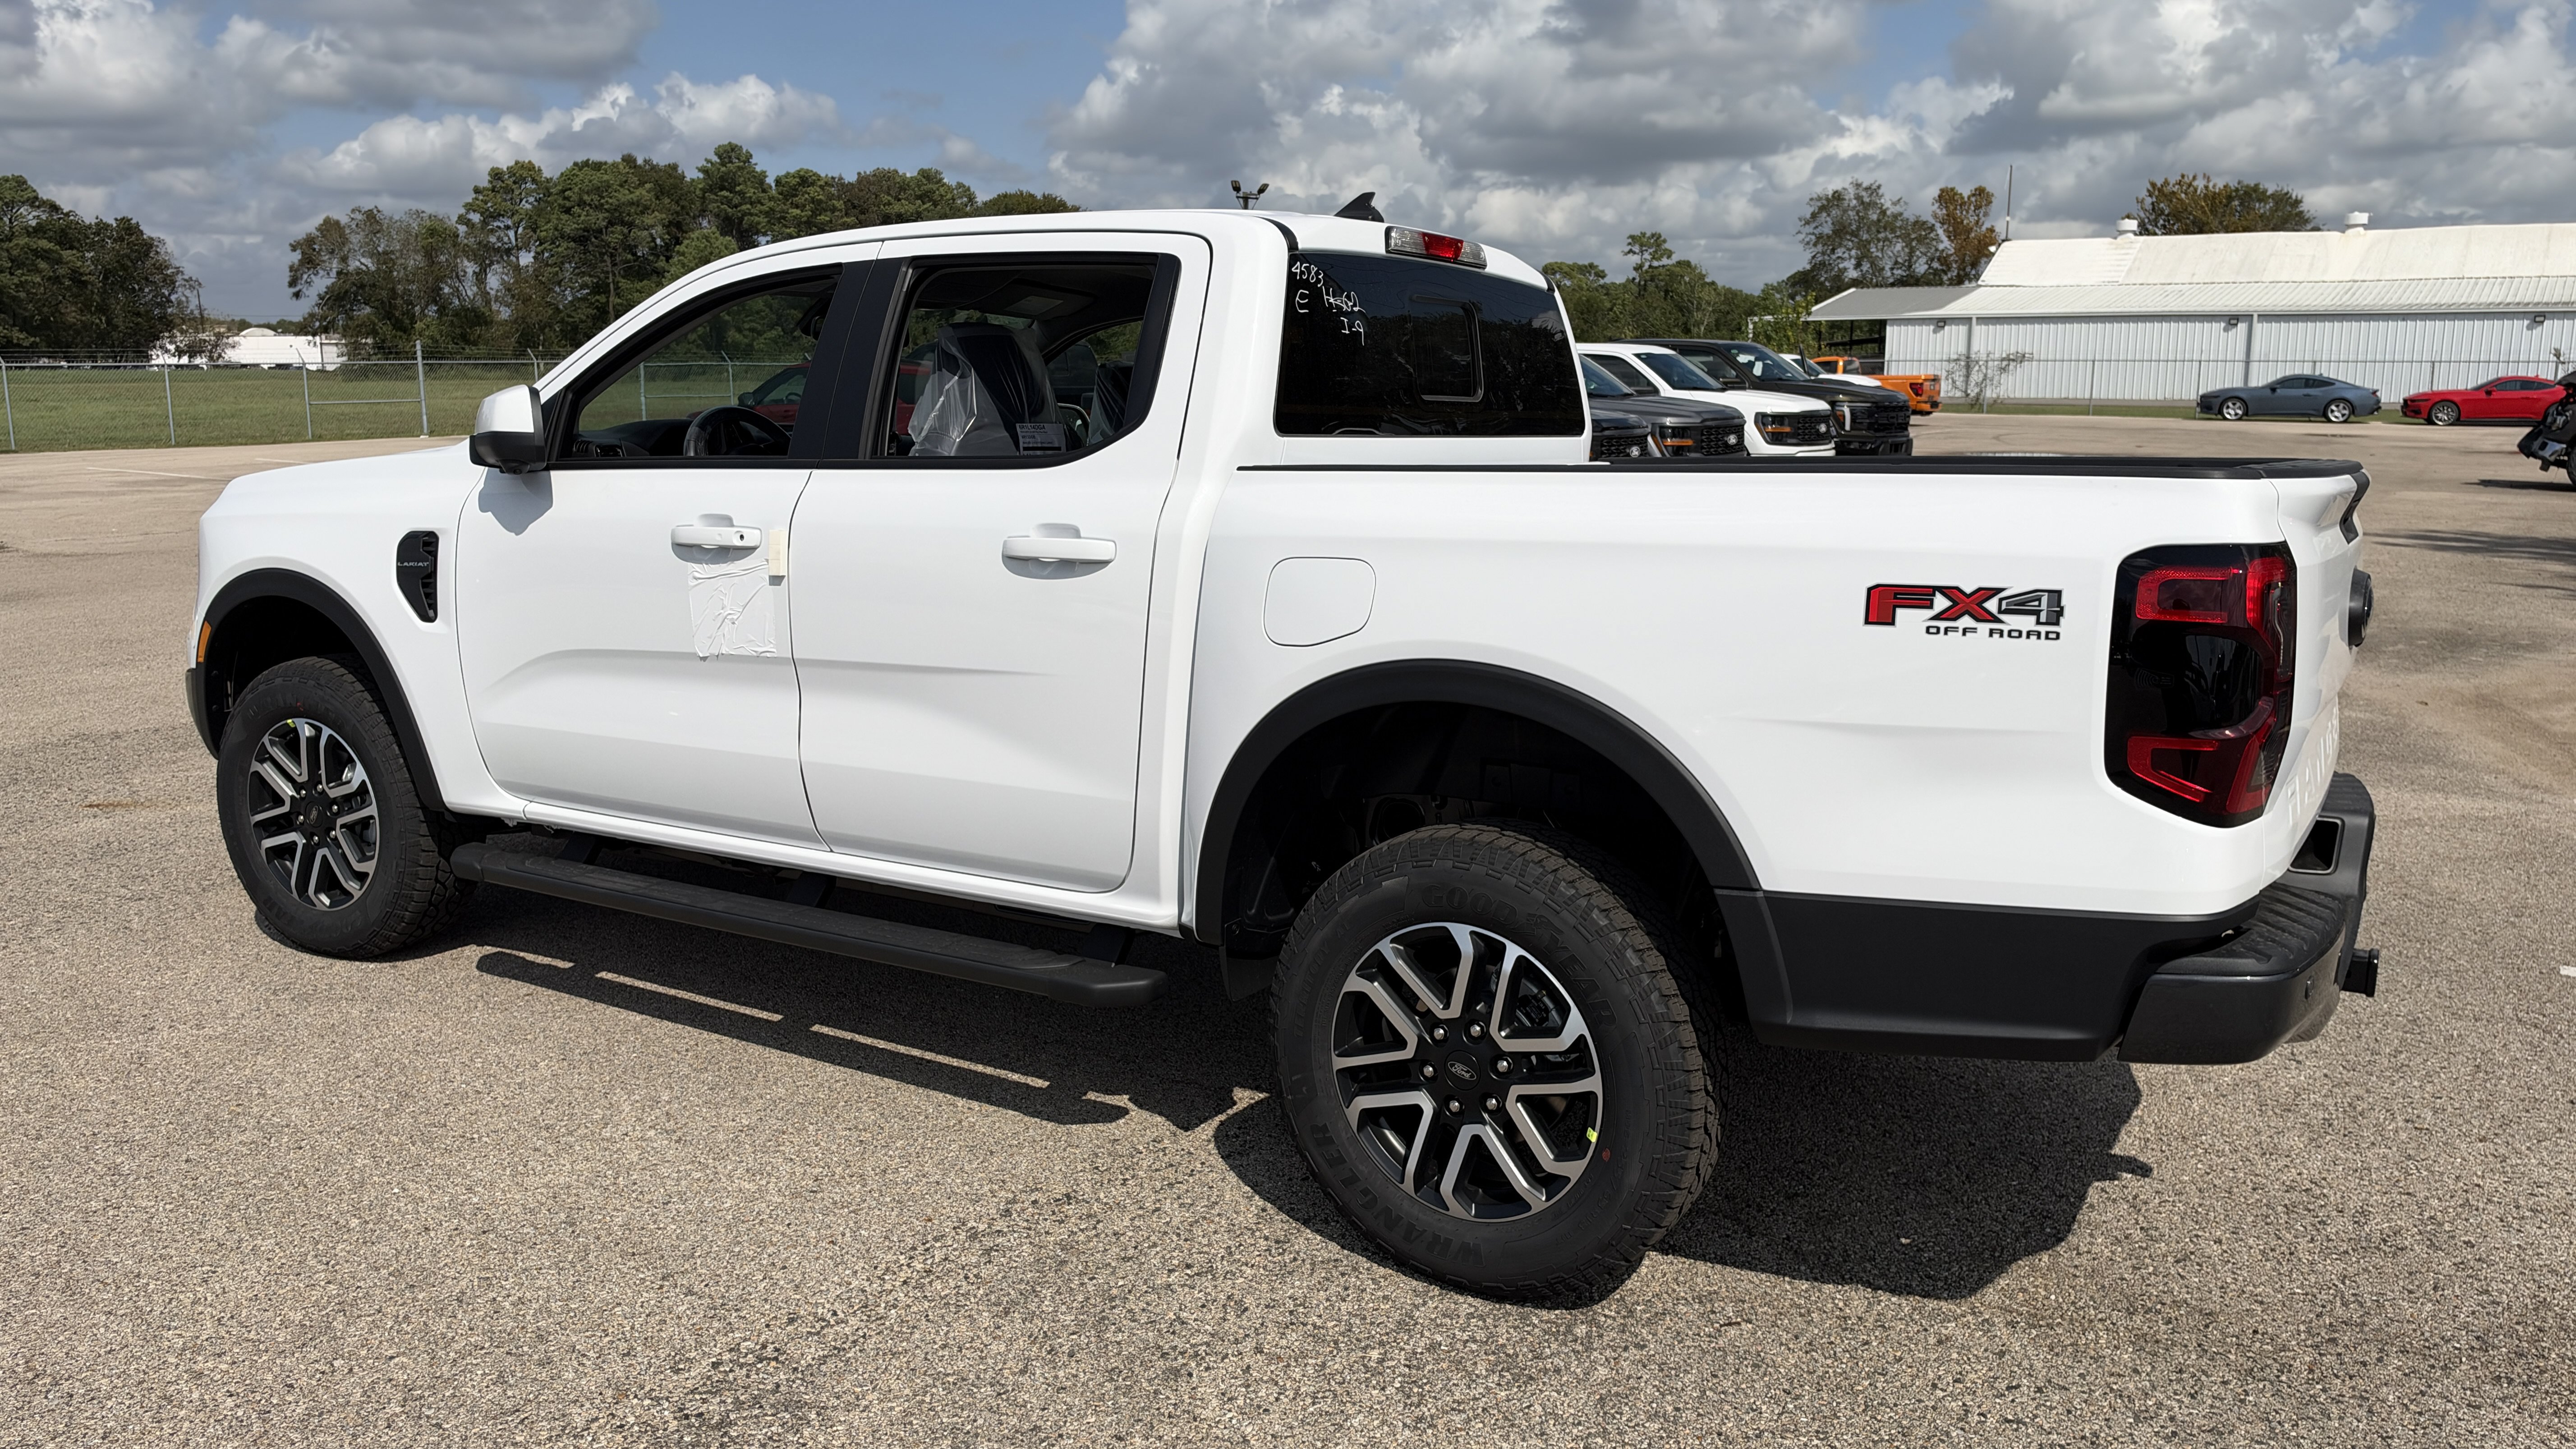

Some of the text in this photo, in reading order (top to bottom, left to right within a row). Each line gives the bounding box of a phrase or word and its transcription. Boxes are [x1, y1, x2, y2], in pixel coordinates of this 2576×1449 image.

[1292, 261, 1324, 287] 4583
[1863, 582, 2065, 627] FX4
[1926, 626, 2060, 640] OFF ROAD
[1309, 1122, 1485, 1265] WRANGLER
